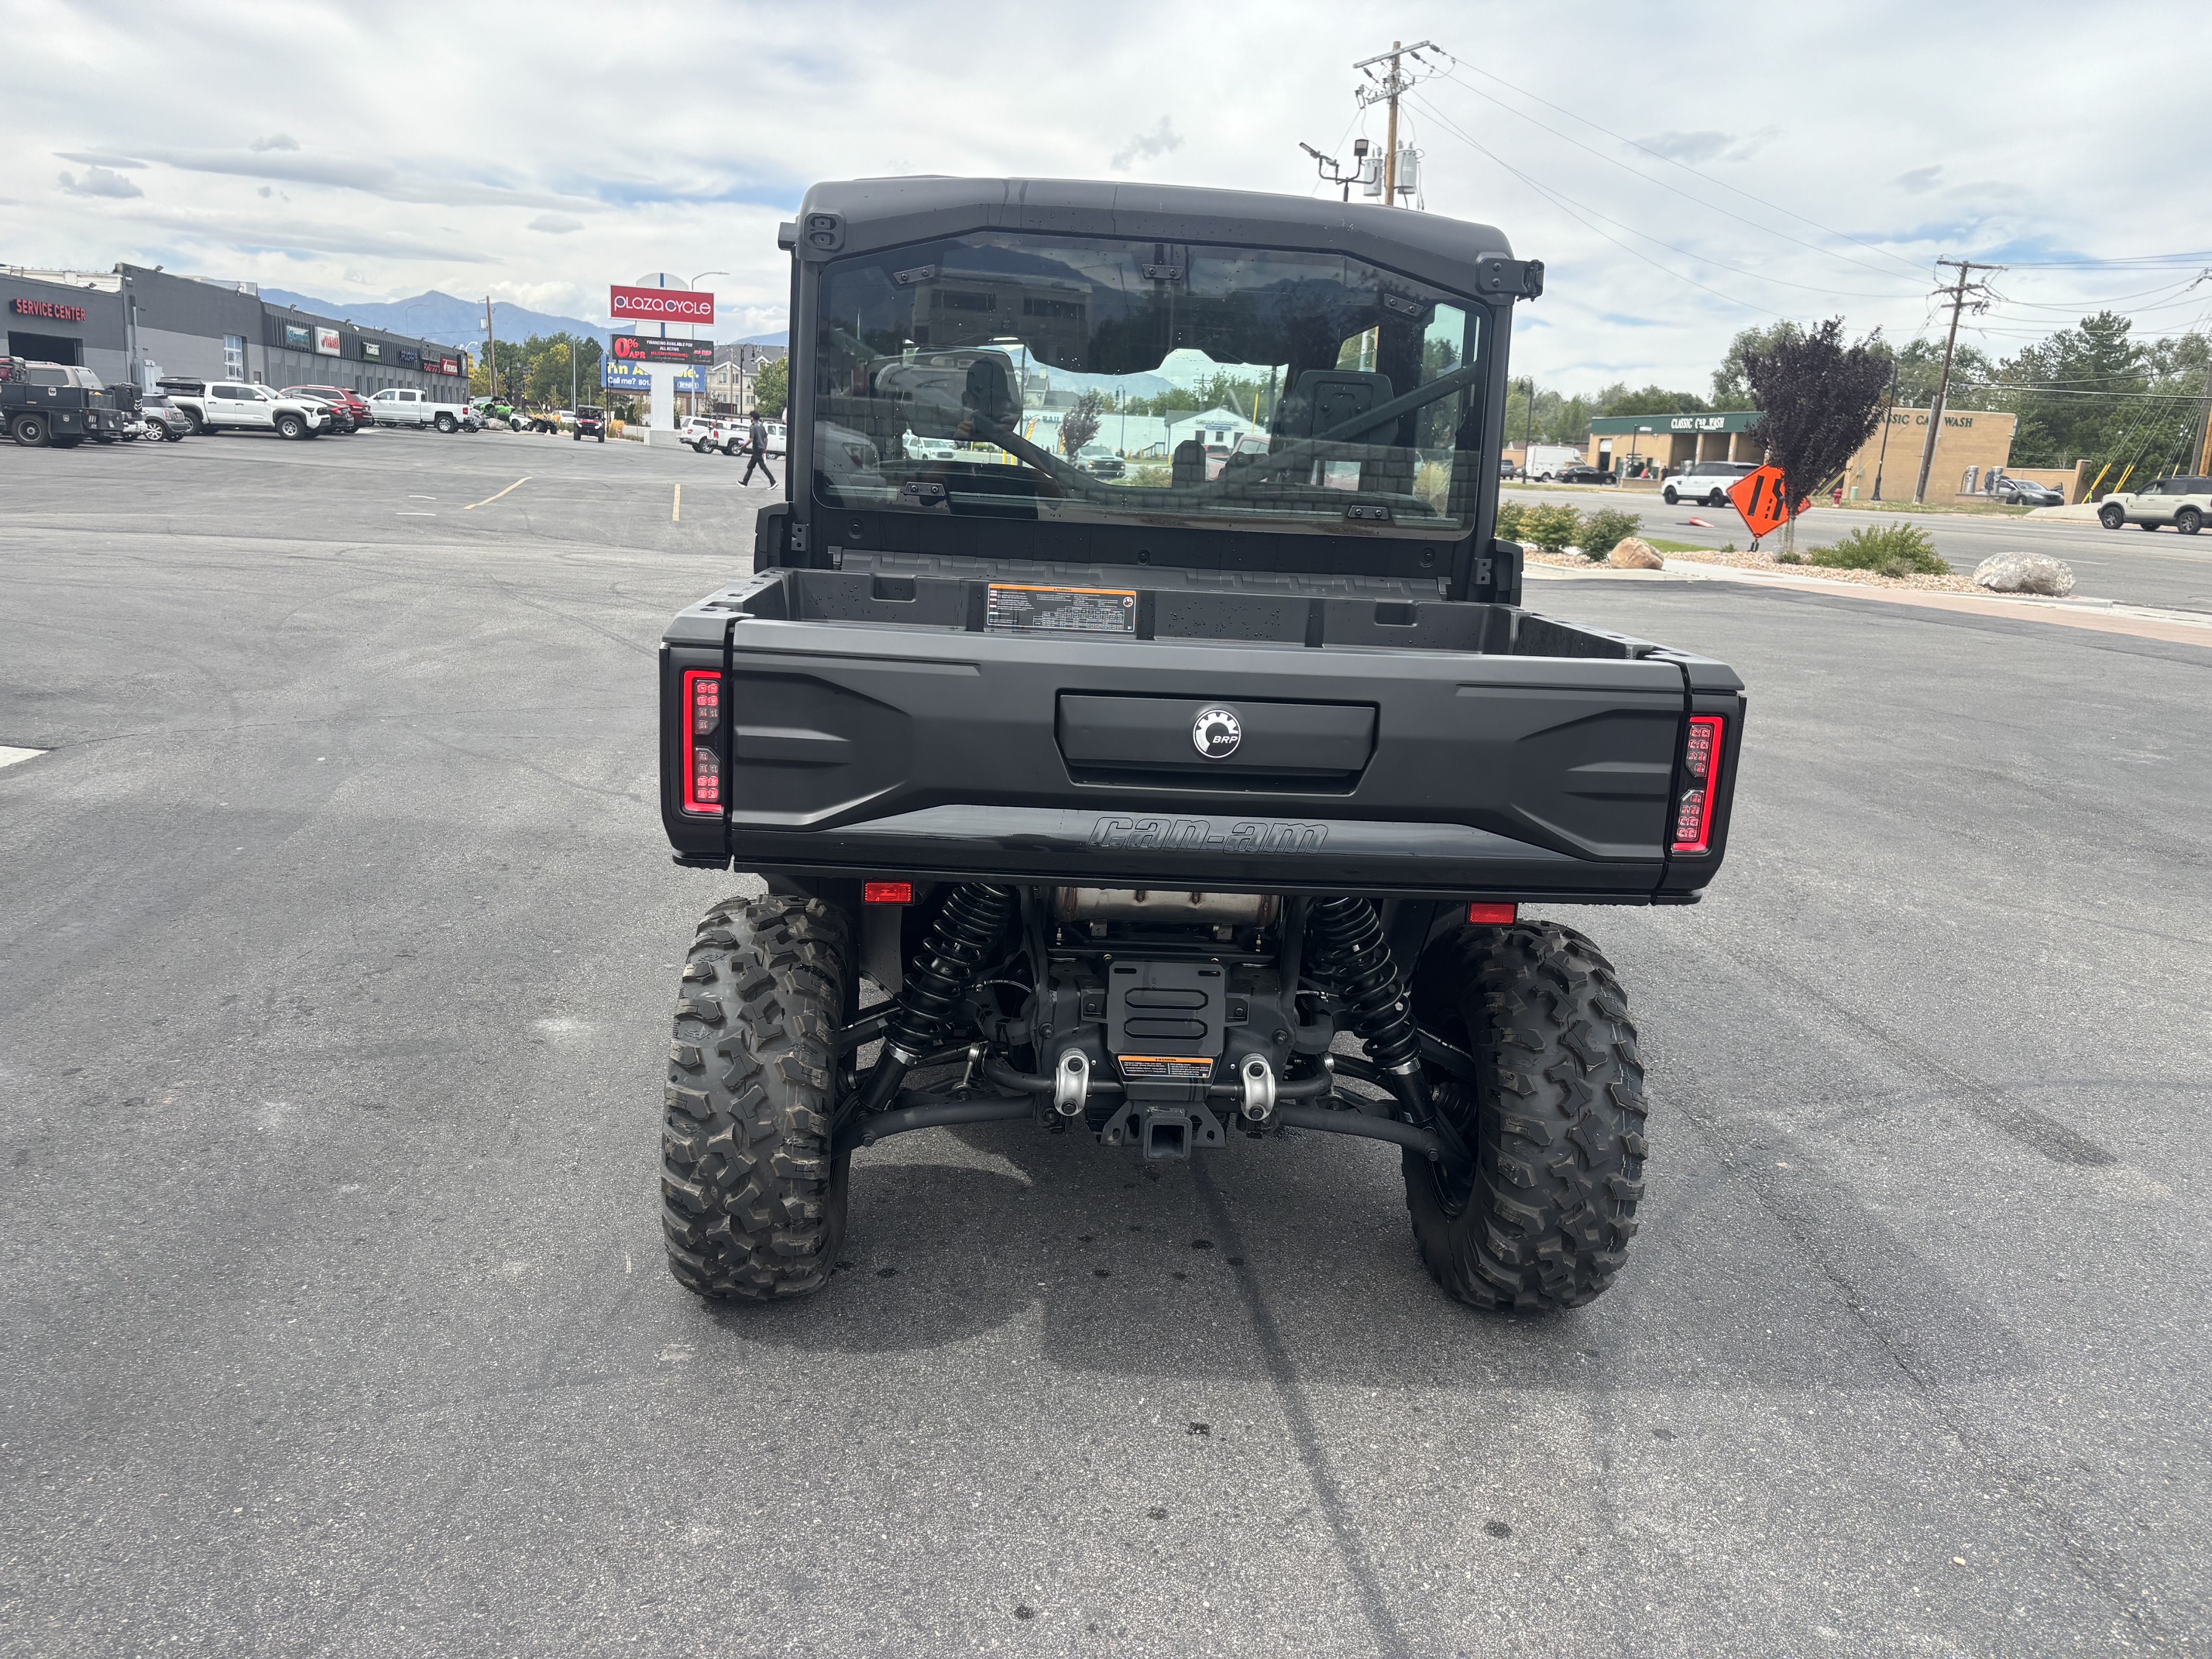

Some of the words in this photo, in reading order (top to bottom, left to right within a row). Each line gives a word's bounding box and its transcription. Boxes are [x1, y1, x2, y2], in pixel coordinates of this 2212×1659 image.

[16, 298, 53, 318] SERVICE
[54, 304, 86, 321] CENTER
[614, 338, 639, 358] 0%
[628, 351, 646, 359] APR
[607, 376, 620, 384] Call
[1671, 417, 1693, 429] CLASSIC
[1695, 417, 1706, 429] CAR
[1915, 415, 1929, 425] CA
[1944, 417, 1973, 428] WASH
[1212, 735, 1238, 744] BRP
[1087, 816, 1328, 857] can-am
